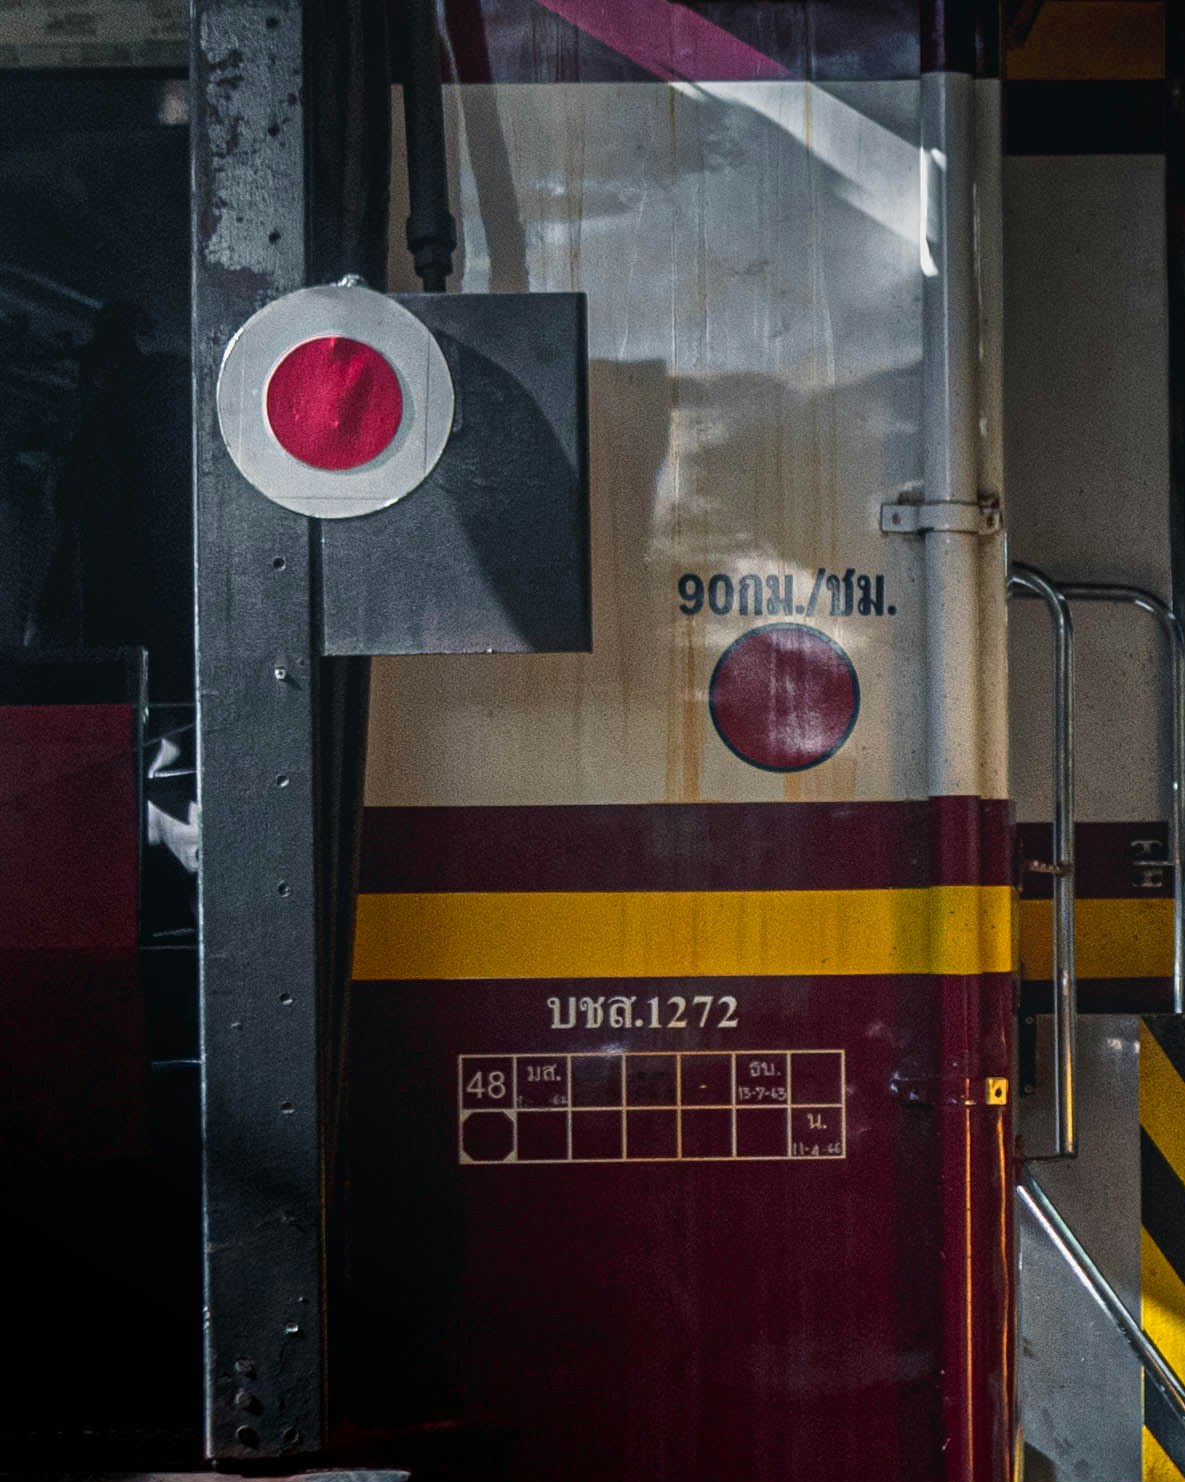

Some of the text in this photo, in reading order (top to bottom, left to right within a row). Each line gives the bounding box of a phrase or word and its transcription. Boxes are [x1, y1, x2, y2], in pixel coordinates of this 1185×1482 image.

[677, 567, 898, 617] 90กม./ชม.
[547, 995, 739, 1029] บชส.1272
[465, 1071, 507, 1099] 48
[527, 1063, 562, 1082] มส.
